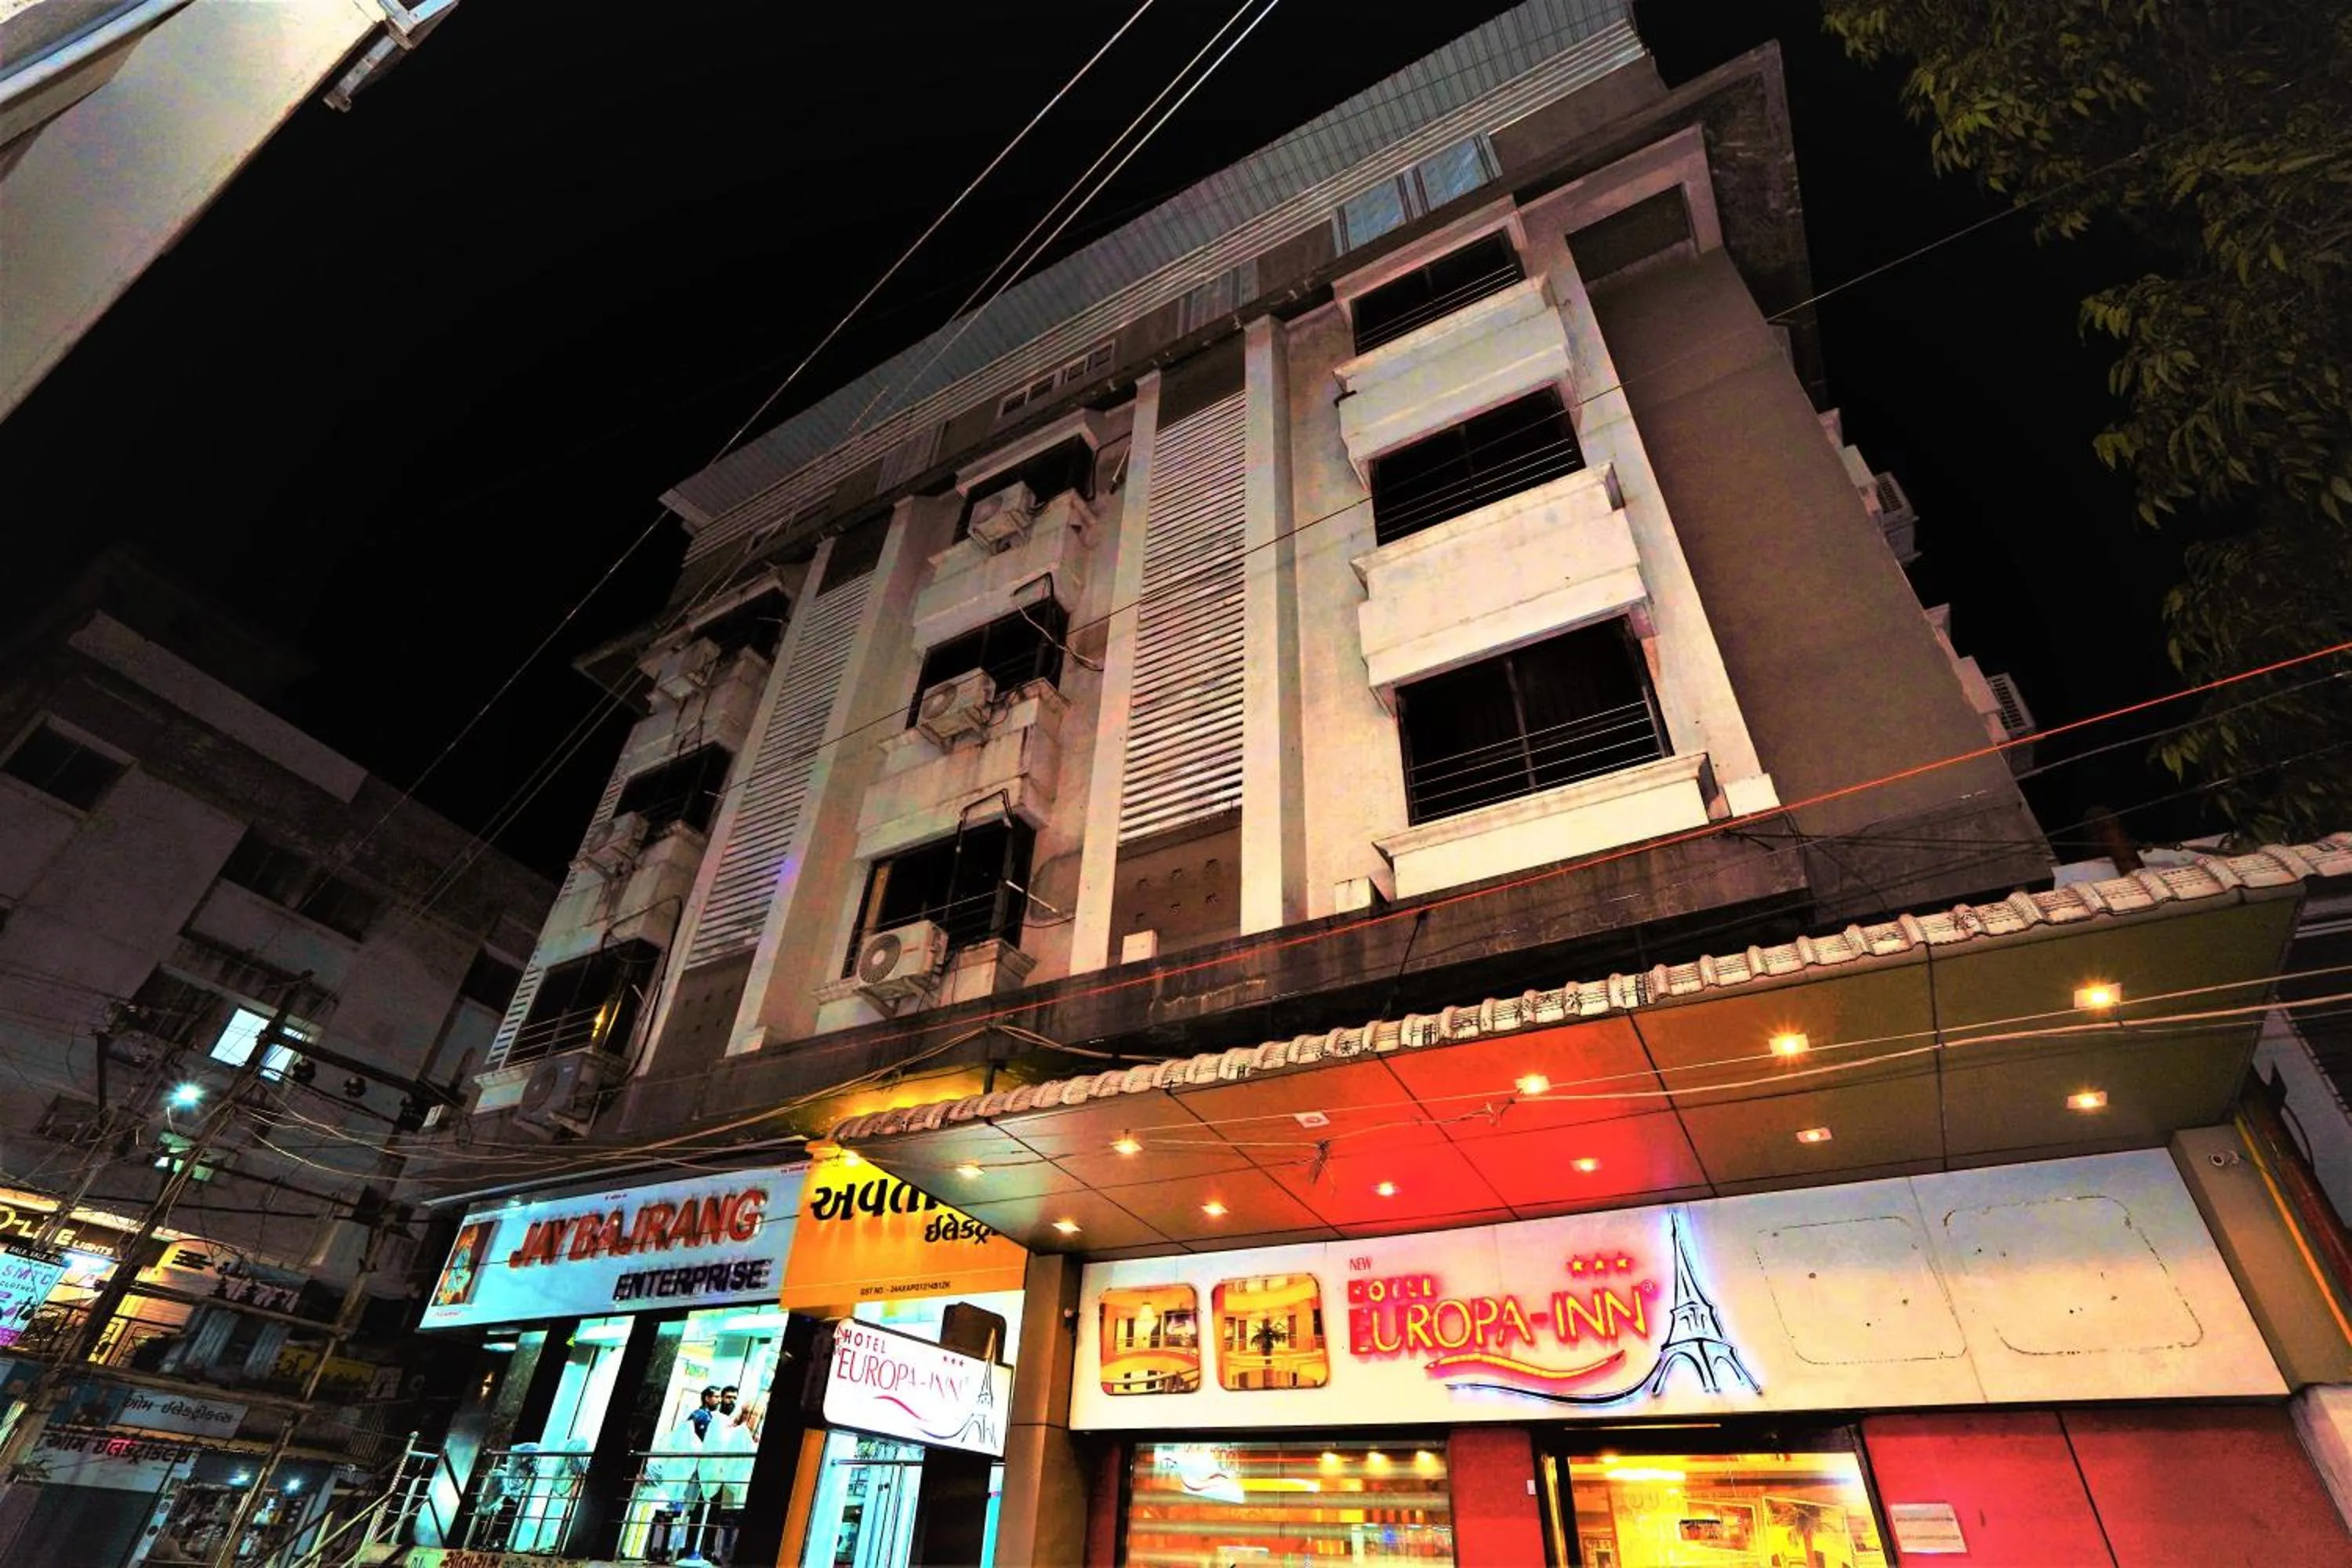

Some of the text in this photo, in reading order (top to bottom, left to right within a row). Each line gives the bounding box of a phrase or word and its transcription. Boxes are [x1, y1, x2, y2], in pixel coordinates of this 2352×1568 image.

[1349, 1256, 1372, 1271] NEW
[612, 1258, 774, 1300] ENTERPRISE
[1348, 1274, 1438, 1303] HOTEL
[844, 1328, 887, 1354] HOTEL
